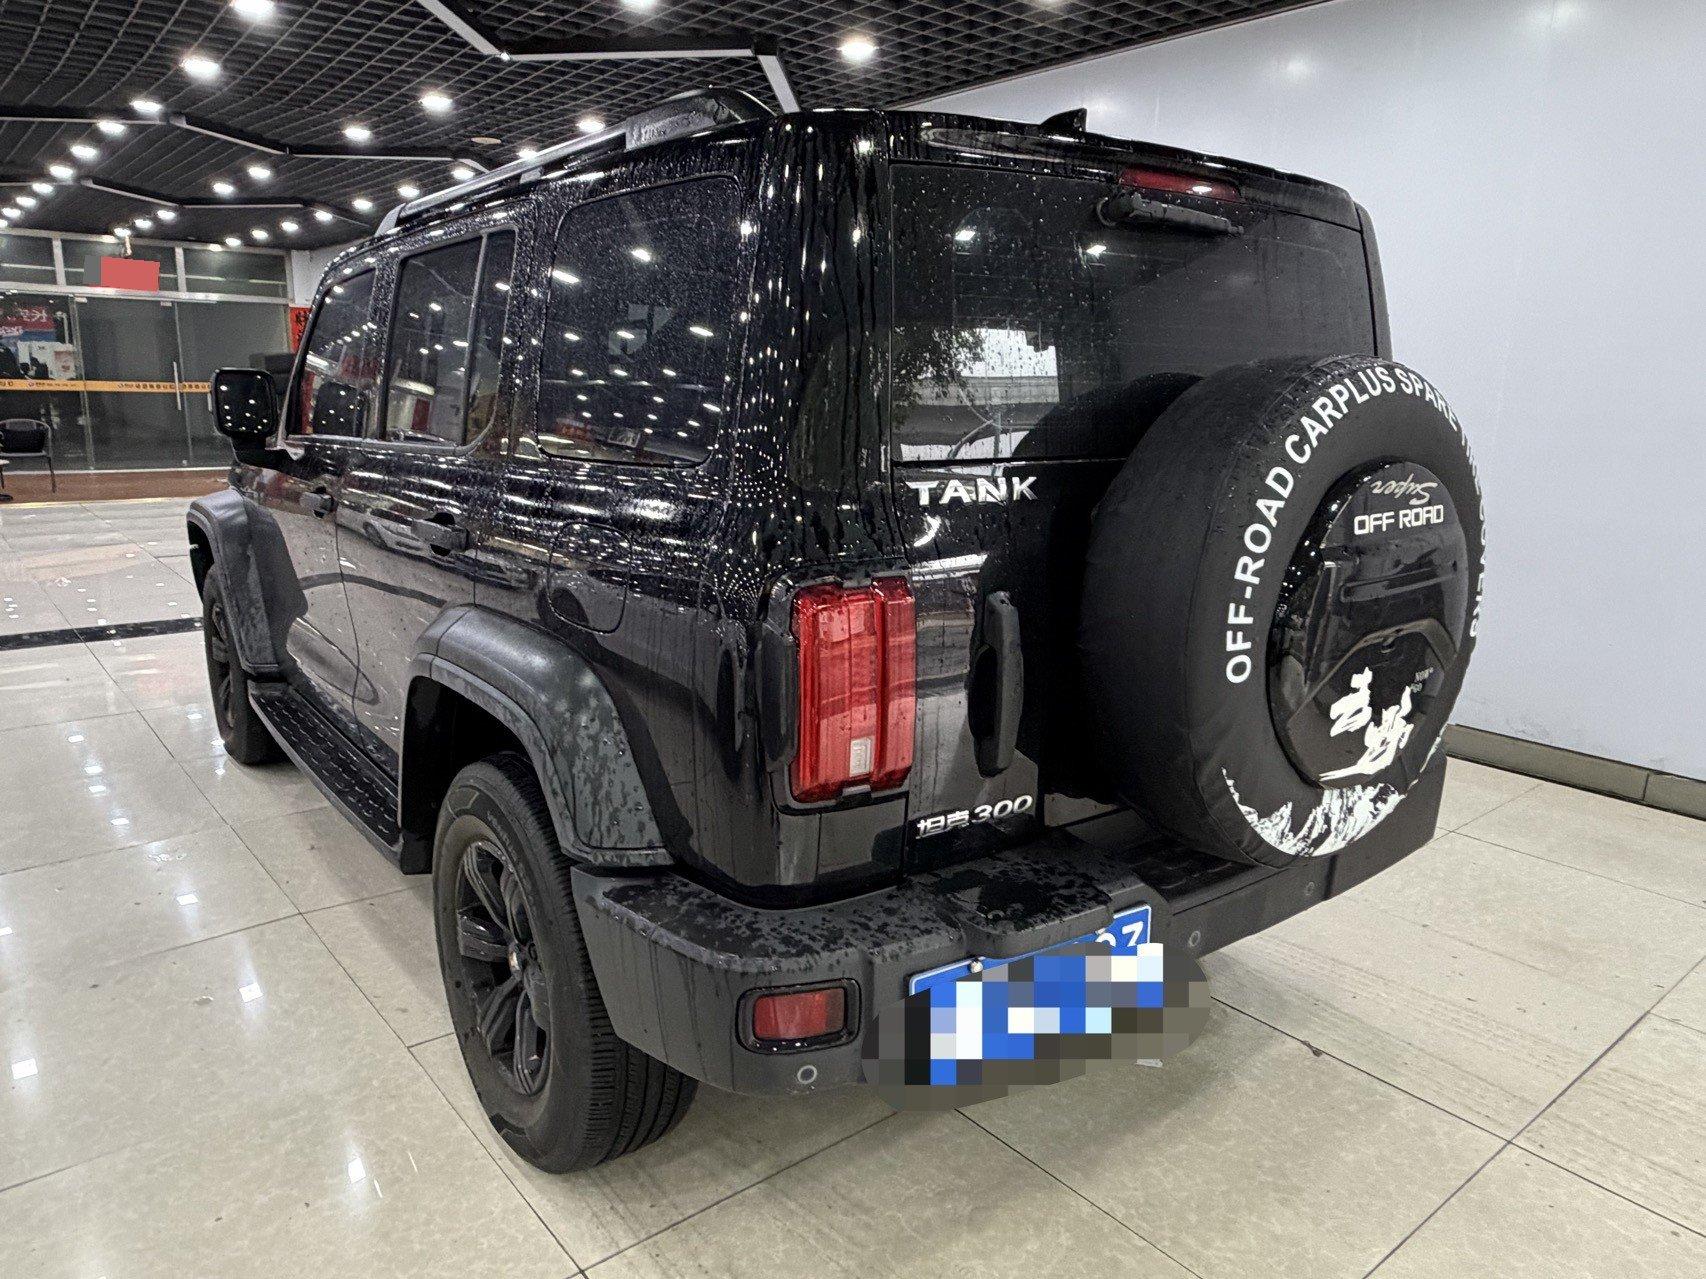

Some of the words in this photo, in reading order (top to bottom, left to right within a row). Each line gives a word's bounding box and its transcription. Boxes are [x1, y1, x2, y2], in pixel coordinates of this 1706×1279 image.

[905, 476, 1038, 506] TANK
[1370, 473, 1438, 505] Super
[1226, 466, 1294, 684] OFF-ROAD
[1285, 366, 1397, 464] CARPLUS
[1354, 511, 1395, 535] OFF
[1399, 504, 1444, 530] ROAD
